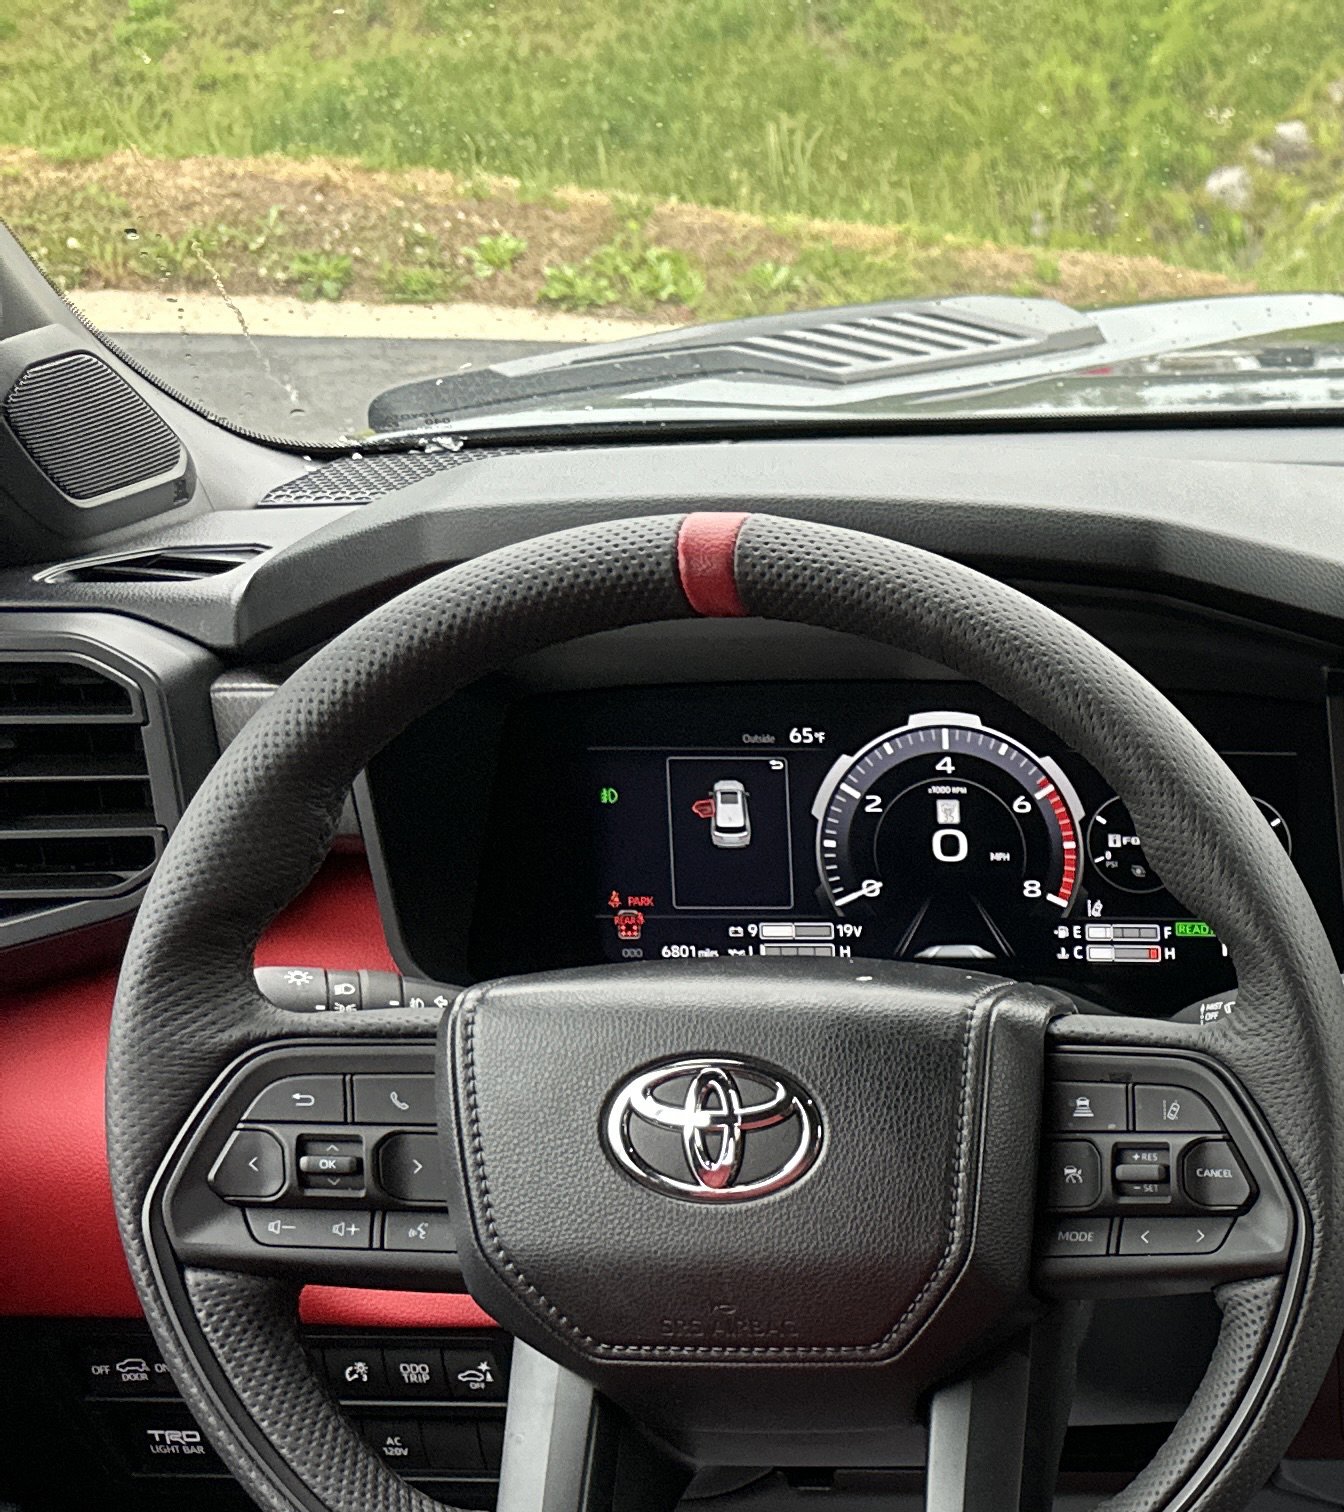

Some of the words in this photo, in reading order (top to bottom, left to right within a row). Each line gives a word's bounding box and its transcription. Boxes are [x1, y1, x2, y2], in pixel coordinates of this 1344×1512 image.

[935, 756, 956, 774] 4
[864, 795, 883, 813] 2
[1012, 796, 1032, 814] 6
[931, 828, 969, 862] 0
[1022, 879, 1042, 898] 8
[628, 896, 654, 907] PARK
[747, 924, 759, 937] 9
[836, 924, 863, 938] 19V
[1073, 926, 1082, 939] E
[1163, 926, 1172, 939] F
[1178, 925, 1215, 936] READ
[661, 945, 695, 958] 6801
[1073, 946, 1083, 959] C
[1164, 947, 1176, 960] H
[1204, 1011, 1220, 1021] OFF
[318, 1159, 337, 1169] OK
[1196, 1168, 1233, 1179] CANCEL
[1058, 1231, 1094, 1242] MODE
[91, 1365, 110, 1375] OFF
[400, 1363, 430, 1374] ODO
[122, 1372, 149, 1382] DOOR
[402, 1374, 430, 1384] TRIP
[147, 1429, 201, 1445] TRD
[386, 1437, 402, 1446] AC
[150, 1445, 180, 1454] LIGHT
[182, 1445, 206, 1454] BAR
